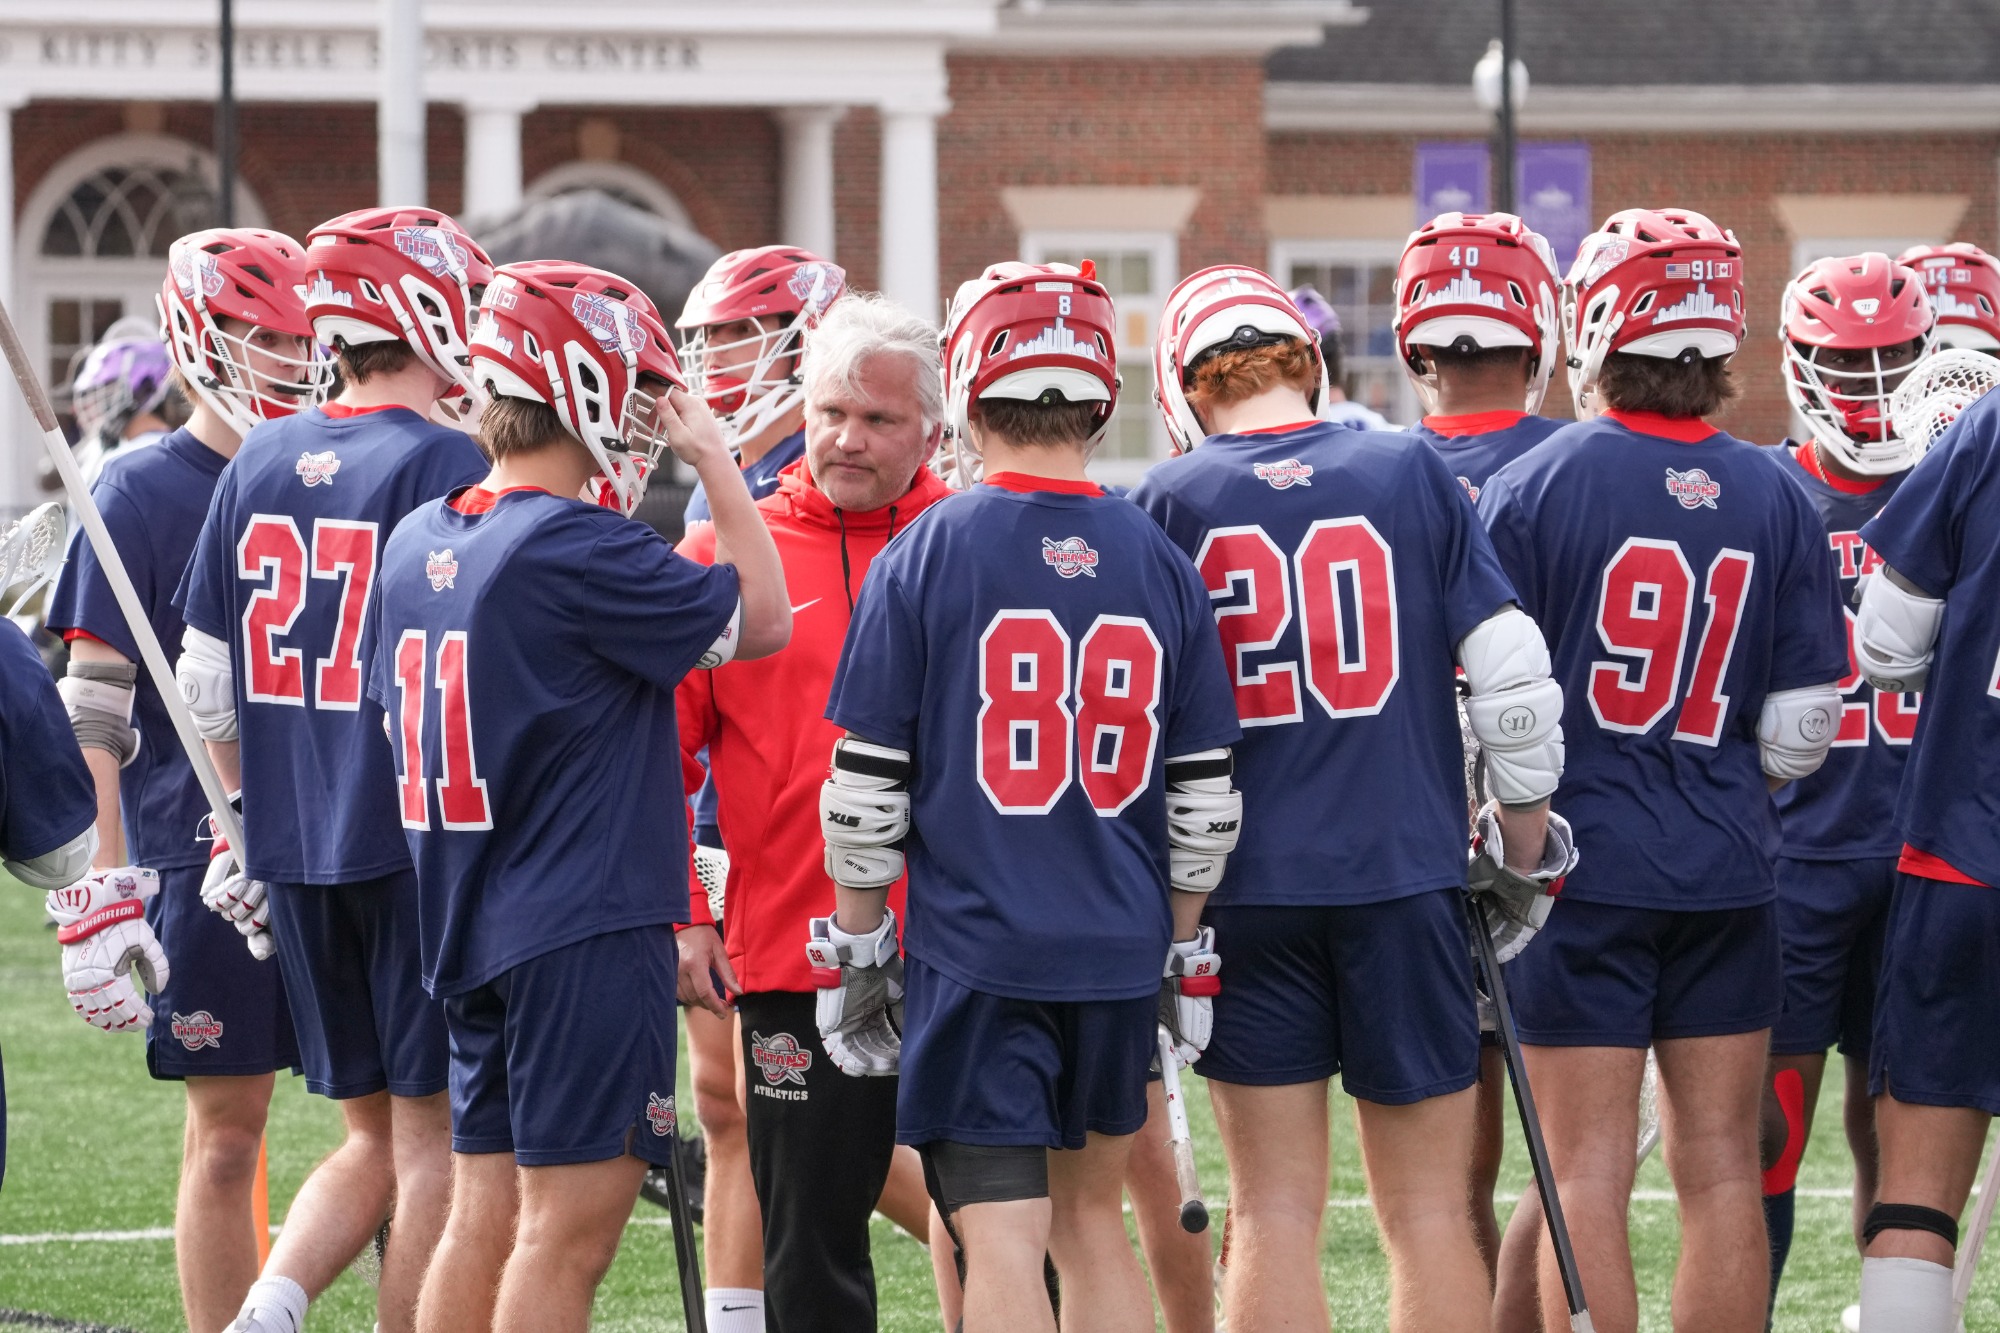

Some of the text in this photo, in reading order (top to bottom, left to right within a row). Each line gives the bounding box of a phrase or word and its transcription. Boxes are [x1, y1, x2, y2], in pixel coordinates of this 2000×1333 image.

[190, 32, 340, 69] SEELE
[365, 33, 520, 71] SORTS
[1449, 246, 1479, 267] 40
[1691, 260, 1714, 281] 91
[1928, 267, 1948, 285] 14
[1058, 295, 1072, 316] 8
[1668, 480, 1718, 497] TITANS
[1045, 549, 1098, 565] TITANS
[237, 513, 378, 711] 27
[1195, 514, 1400, 728] 20
[1587, 536, 1755, 747] 91
[976, 608, 1163, 818] 88
[395, 629, 494, 831] 11
[77, 905, 136, 935] WARRIOR
[809, 949, 826, 962] 88
[1195, 961, 1211, 976] 88
[174, 1023, 221, 1037] TITANS
[754, 1047, 809, 1068] TITANS
[754, 1084, 809, 1101] ATHLETICS
